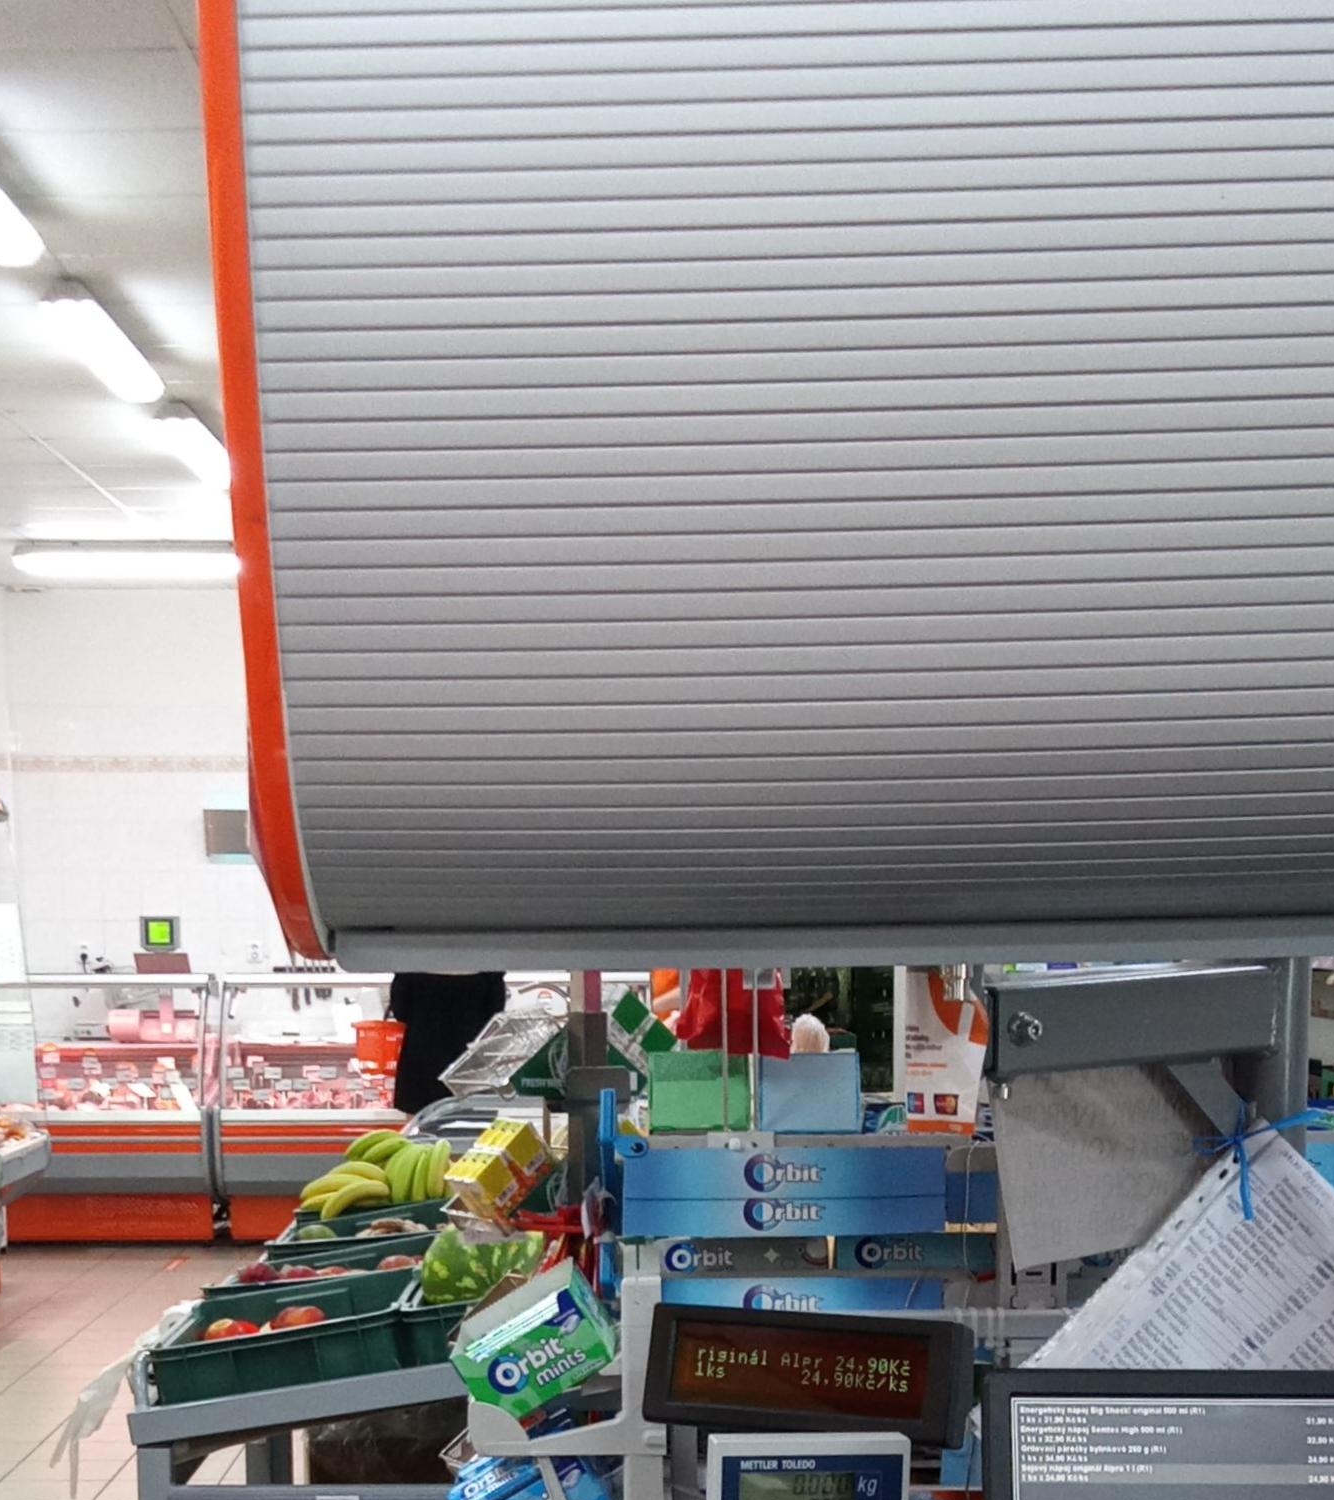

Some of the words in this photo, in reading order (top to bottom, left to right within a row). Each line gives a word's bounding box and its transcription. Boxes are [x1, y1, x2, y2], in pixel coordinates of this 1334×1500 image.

[747, 1155, 825, 1188] Orbit
[747, 1201, 825, 1227] Orbit
[670, 1247, 733, 1271] Orbit
[860, 1241, 924, 1264] Orbit
[496, 1337, 565, 1388] Orbit
[536, 1349, 586, 1387] mints
[694, 1362, 726, 1379] 1ks
[739, 1460, 779, 1471] METTLER
[781, 1459, 816, 1470] TOLEDO
[857, 1475, 878, 1497] kg
